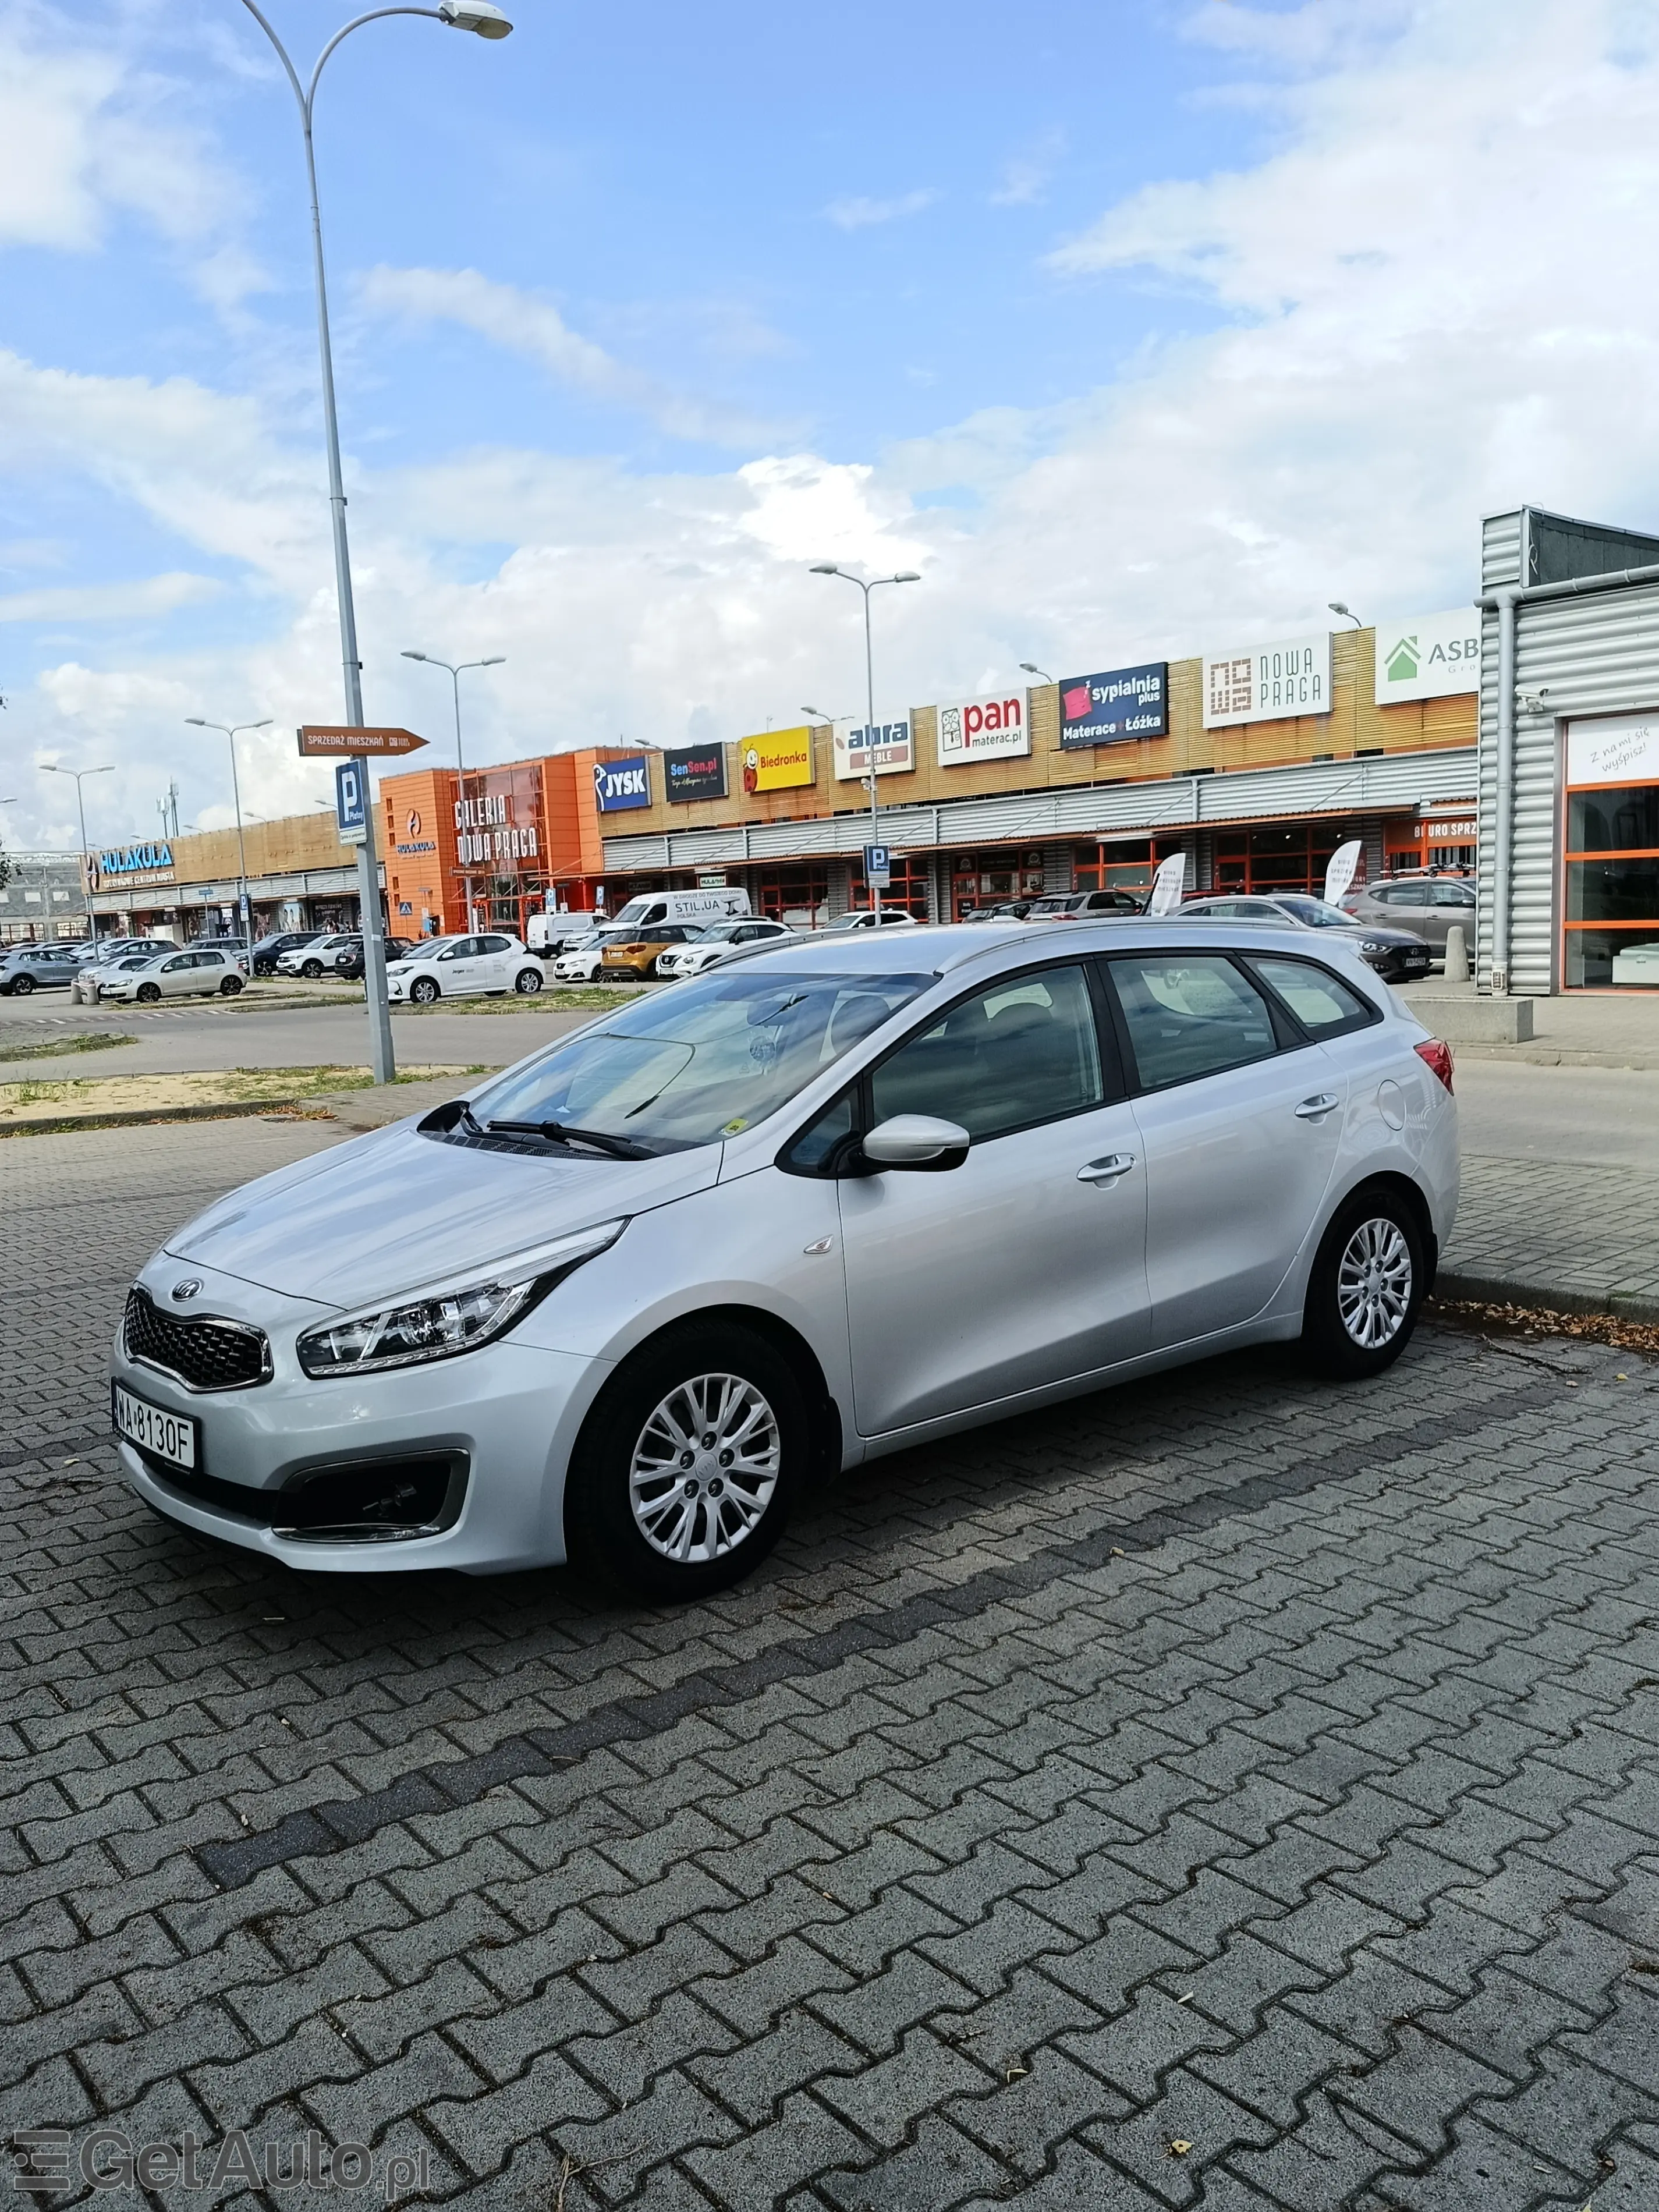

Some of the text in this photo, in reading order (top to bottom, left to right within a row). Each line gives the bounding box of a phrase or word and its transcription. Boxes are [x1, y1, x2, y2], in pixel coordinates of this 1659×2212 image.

[1260, 648, 1312, 680] NOWA
[1428, 639, 1479, 664] ASB
[1448, 664, 1476, 673] Gro
[1091, 675, 1160, 704] sypialnia
[1138, 691, 1160, 706] plus
[1261, 675, 1320, 708] PRAGA
[848, 722, 908, 749] abra
[964, 699, 1020, 748] pan
[1063, 722, 1116, 740] Materace
[1125, 714, 1161, 731] Łóżka
[1635, 726, 1650, 740] się
[307, 735, 345, 746] SPRZEDAŻ
[347, 735, 384, 746] MIESZKAŃ
[972, 730, 1022, 747] materac.pl
[671, 757, 717, 777] SenSen.pl
[760, 751, 807, 768] Biedronka
[1602, 743, 1647, 772] wyśpisz!
[605, 768, 646, 797] JYSK
[342, 771, 357, 822] P
[494, 827, 537, 860] PRAGA
[1414, 824, 1448, 838] BIURO
[100, 843, 172, 874] HULAKULA
[873, 849, 885, 869] P
[675, 900, 720, 912] STIL.UA
[137, 1405, 189, 1460] 8130F
